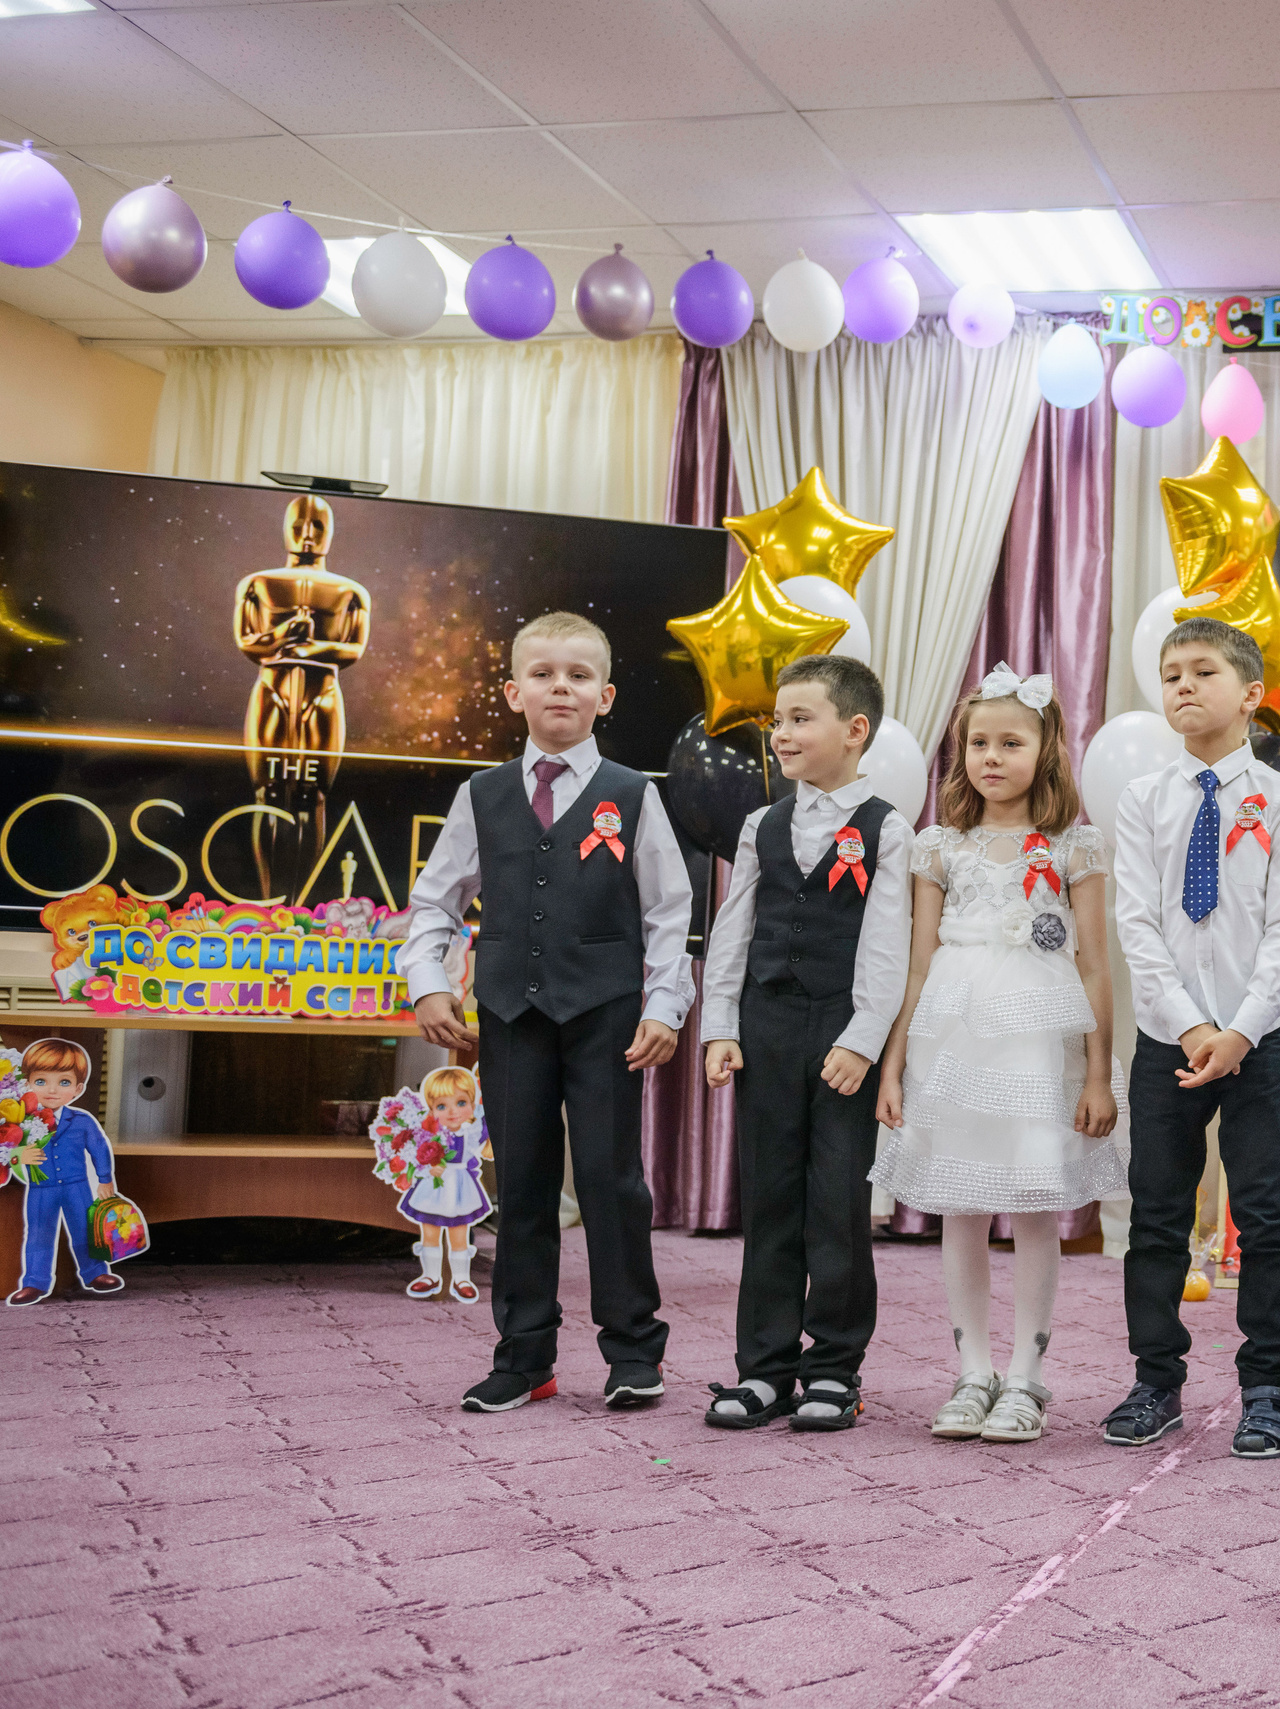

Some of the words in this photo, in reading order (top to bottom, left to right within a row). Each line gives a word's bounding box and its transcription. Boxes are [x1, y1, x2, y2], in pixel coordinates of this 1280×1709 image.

[1101, 294, 1183, 346] ДО
[266, 757, 320, 782] THE
[0, 793, 480, 912] OSCA
[90, 929, 156, 969] ДО
[305, 981, 392, 1014] сад!
